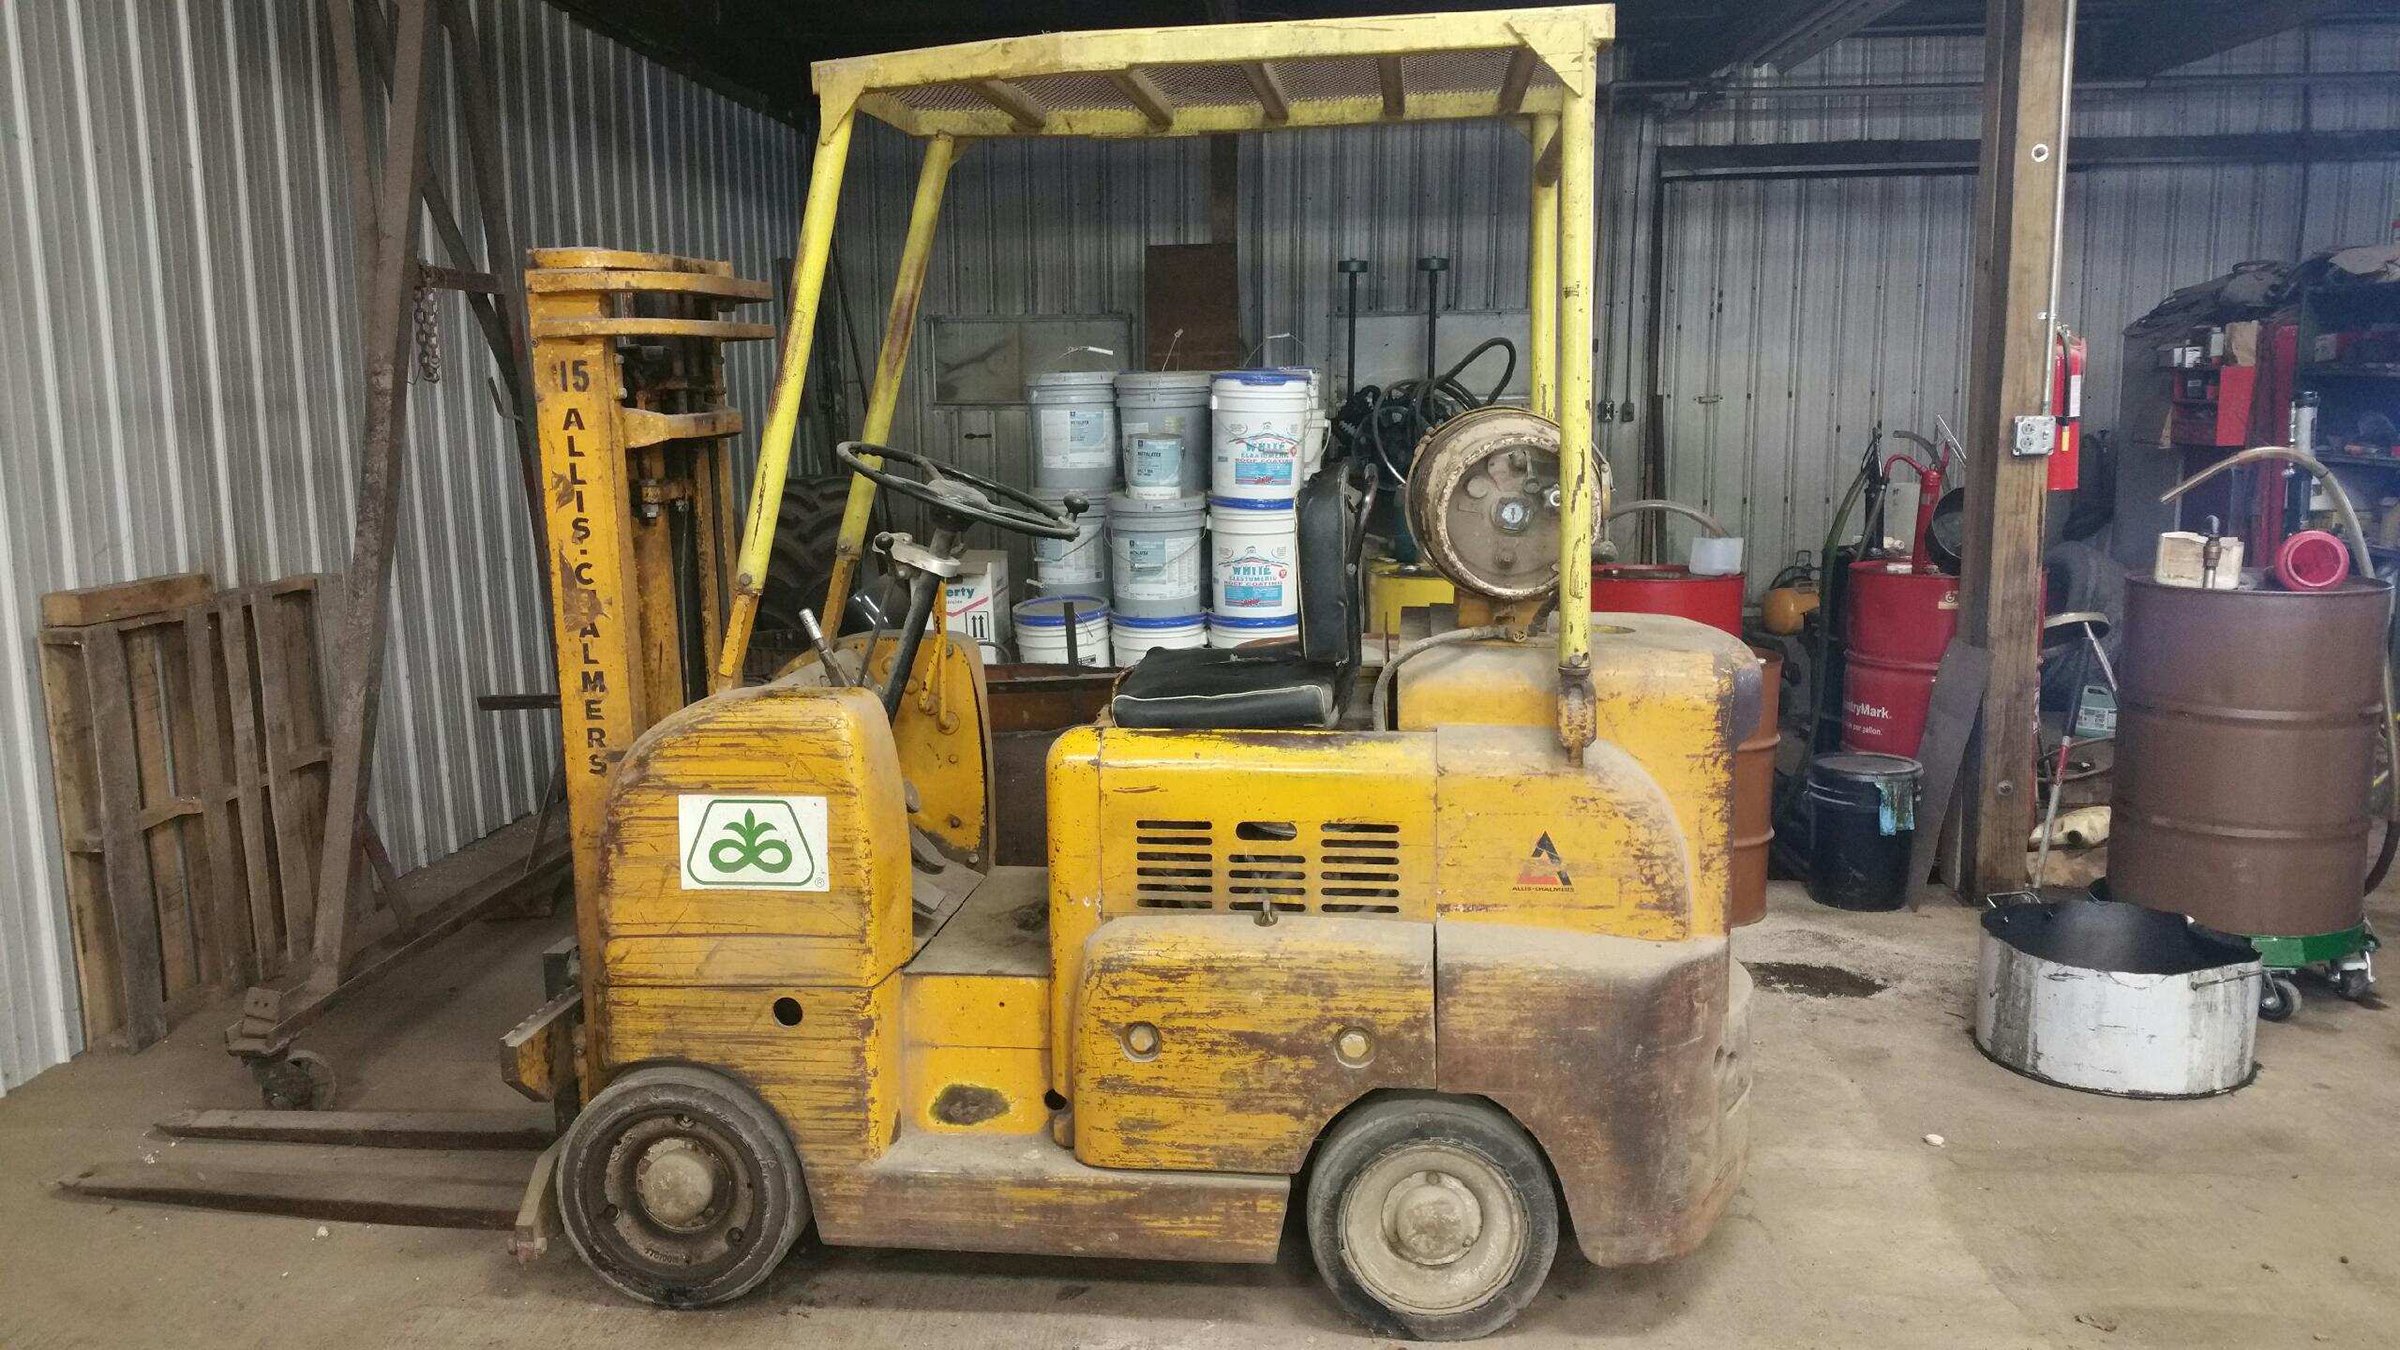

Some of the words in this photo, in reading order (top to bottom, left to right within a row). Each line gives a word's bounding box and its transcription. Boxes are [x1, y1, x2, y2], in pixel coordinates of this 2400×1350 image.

[560, 360, 590, 392] 15
[561, 407, 608, 777] ALLIS-CALMERS
[946, 586, 975, 599] erty
